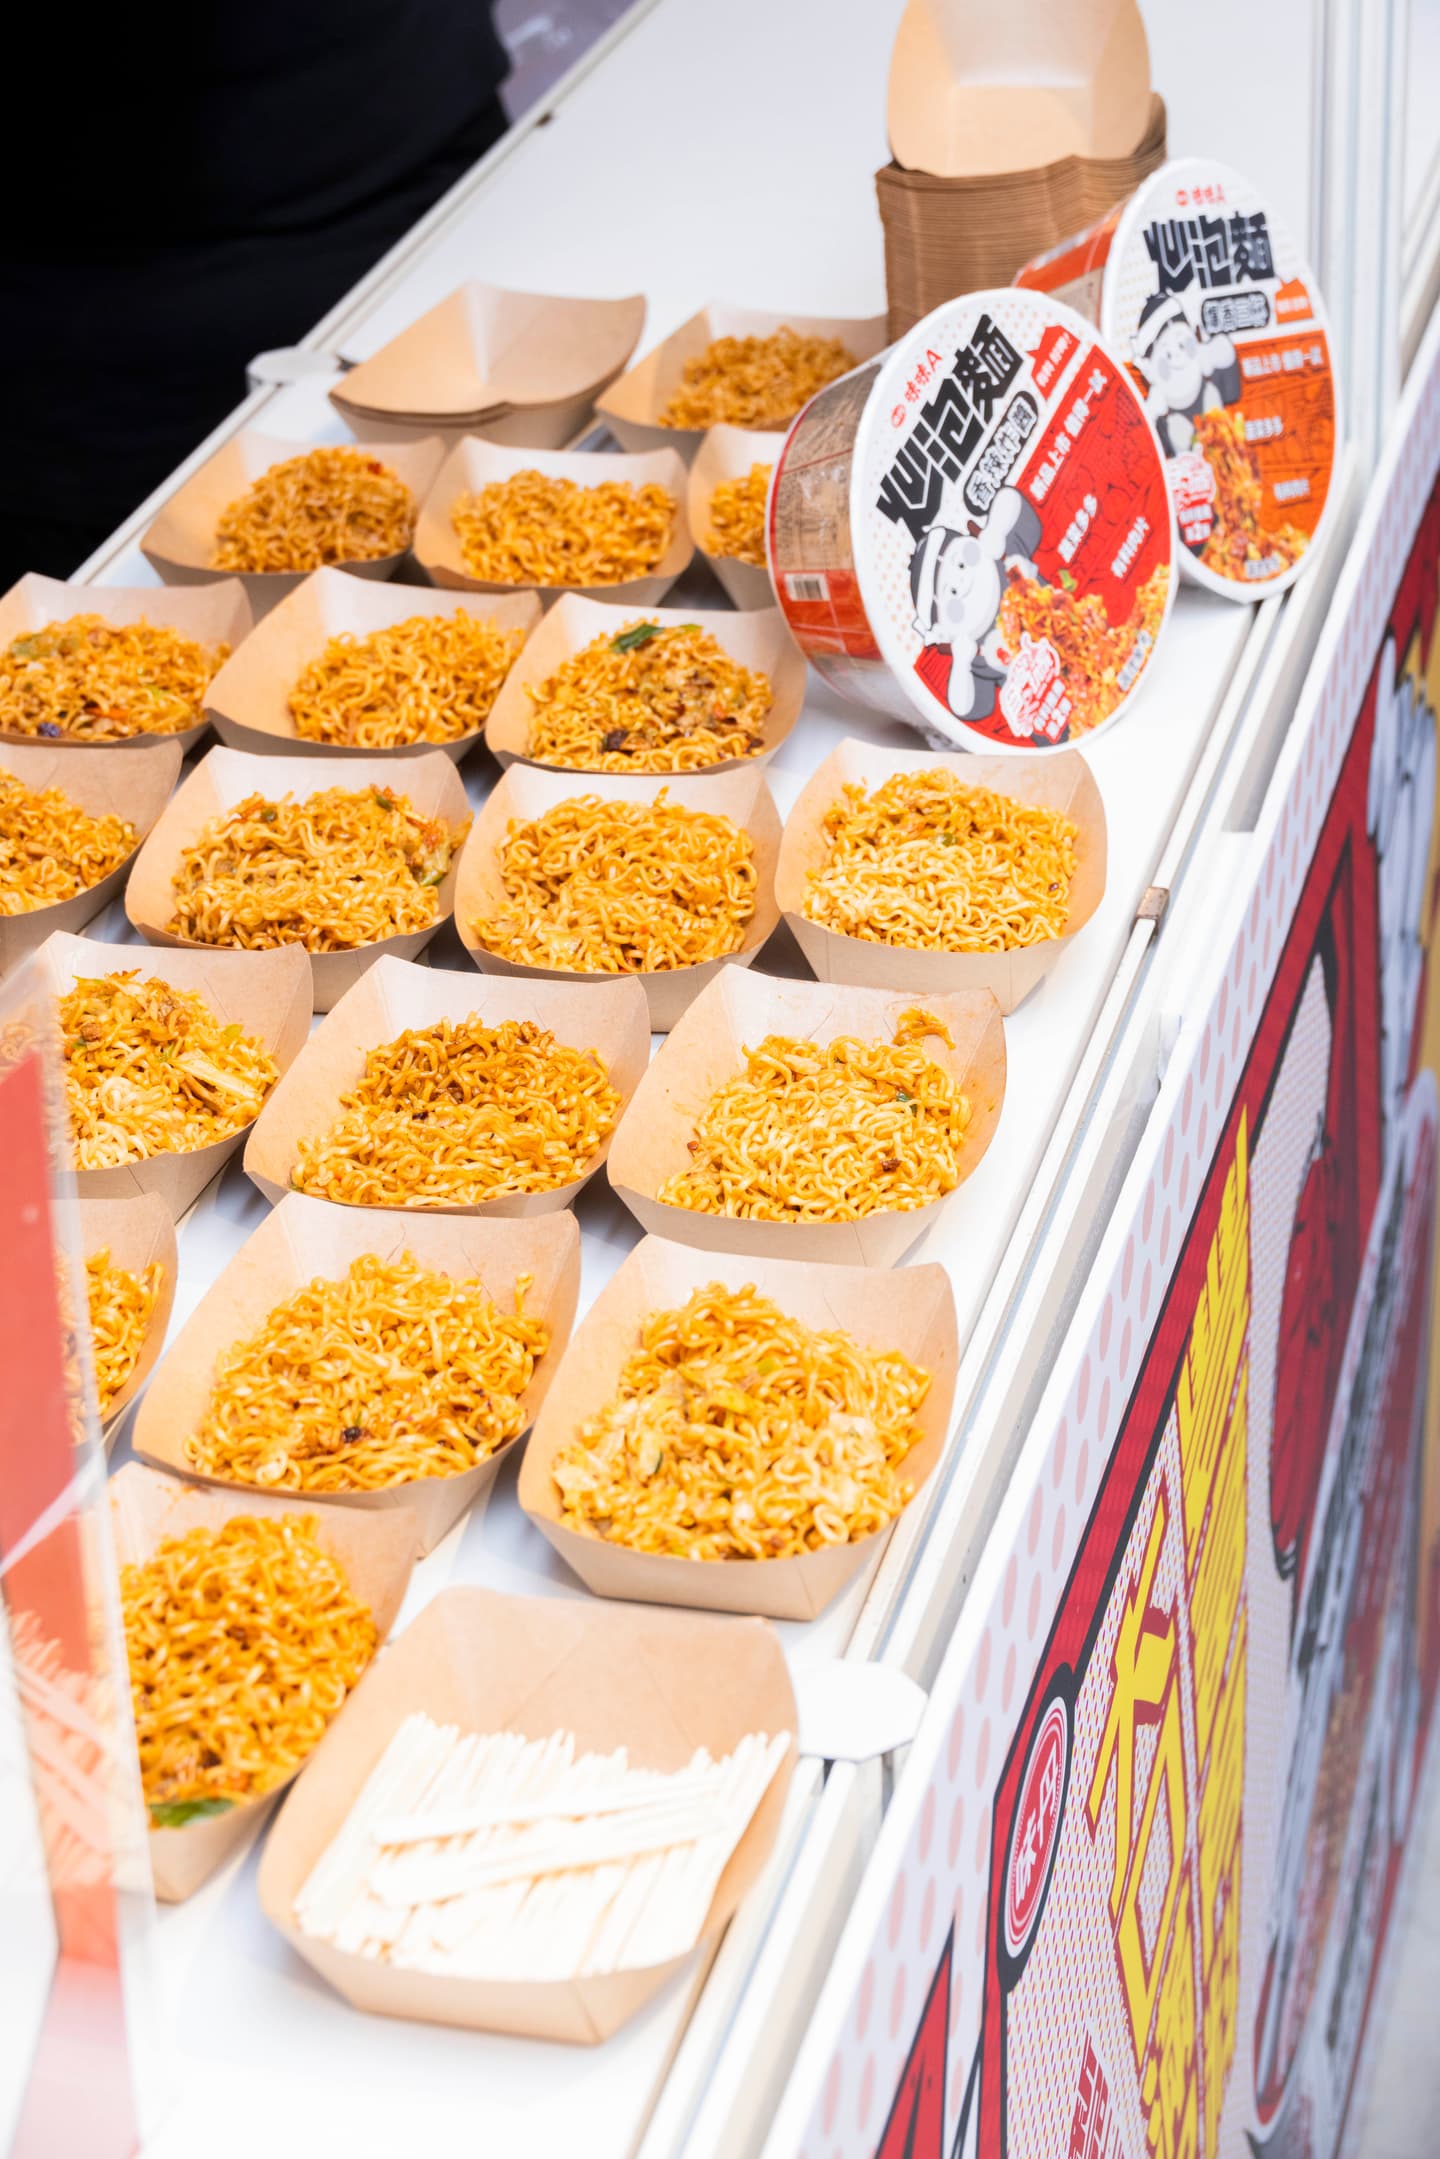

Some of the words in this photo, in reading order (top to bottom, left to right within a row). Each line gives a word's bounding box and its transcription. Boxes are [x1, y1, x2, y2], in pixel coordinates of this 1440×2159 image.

[1143, 211, 1275, 296] 炒泡麵
[876, 314, 1024, 543] 炒泡麵
[965, 398, 1037, 510] 香辣炸醬
[1014, 1739, 1062, 1911] 味丹
